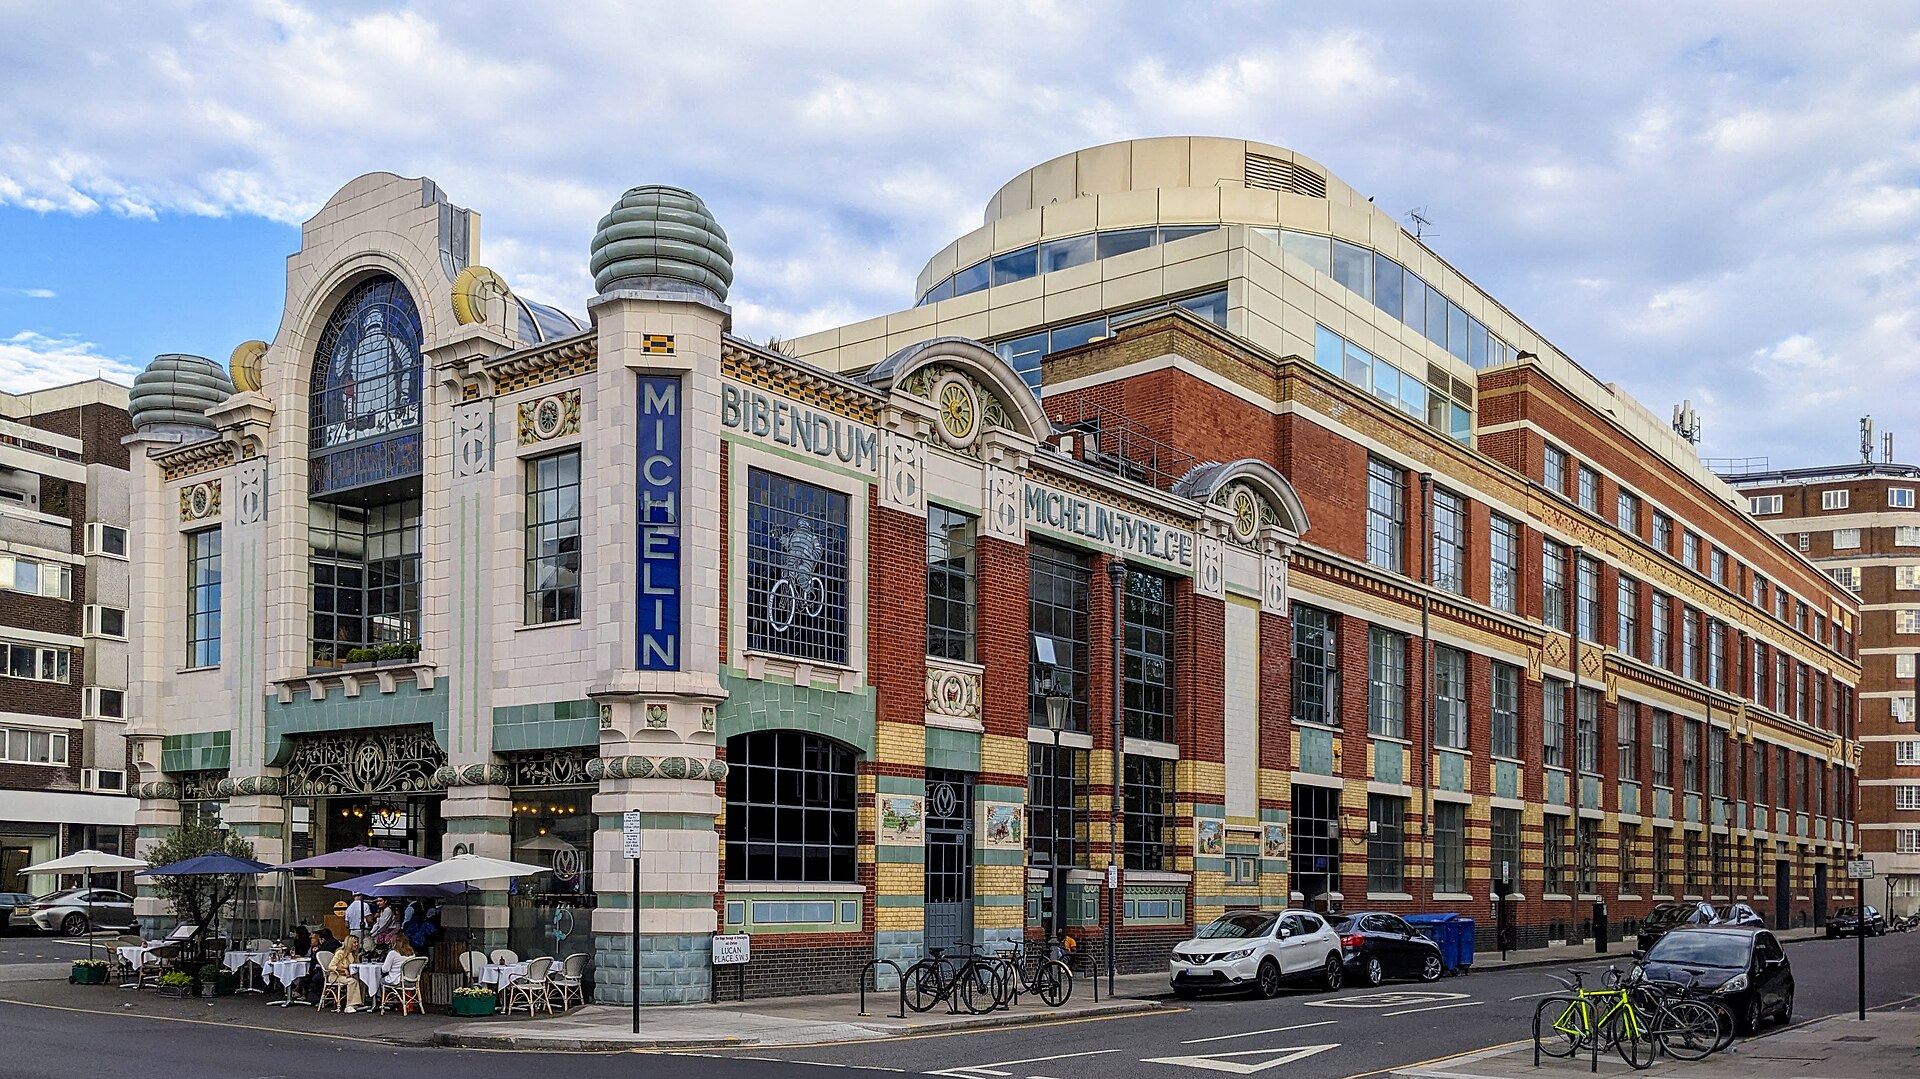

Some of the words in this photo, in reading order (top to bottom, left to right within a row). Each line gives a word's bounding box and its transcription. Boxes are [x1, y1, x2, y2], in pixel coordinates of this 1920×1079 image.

[721, 382, 878, 472] BIBENDUM
[643, 382, 676, 667] MICHELIN
[721, 946, 742, 955] LUCAN
